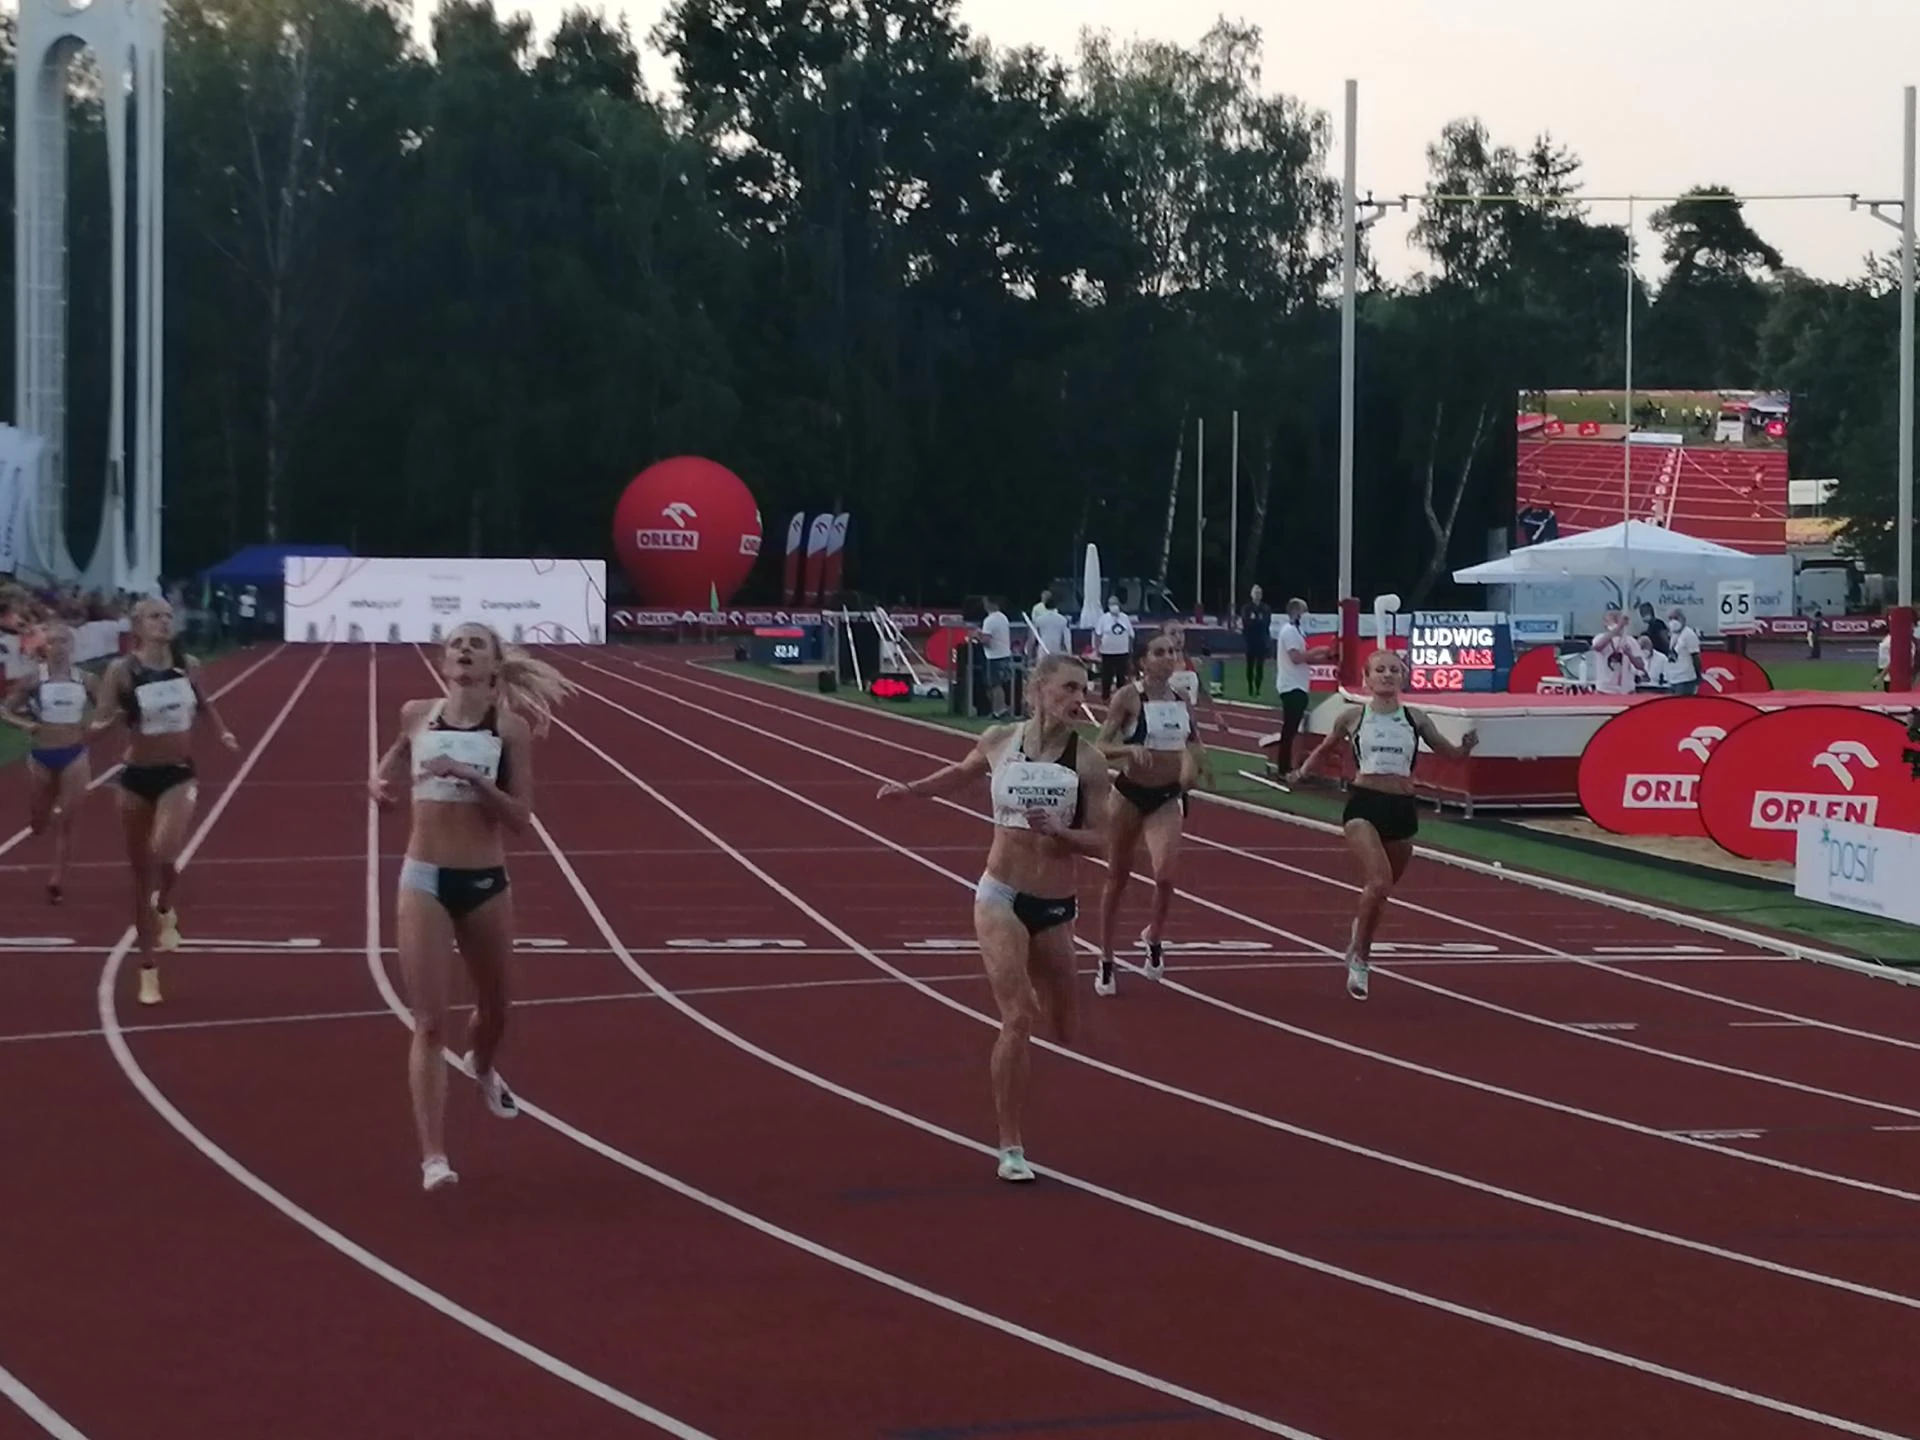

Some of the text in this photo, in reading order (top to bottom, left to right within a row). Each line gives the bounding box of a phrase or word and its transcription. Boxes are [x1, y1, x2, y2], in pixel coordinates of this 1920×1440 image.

[639, 533, 695, 547] ORLEN
[1721, 594, 1750, 615] 65
[1421, 613, 1471, 624] TYCZKA
[1412, 627, 1495, 647] LUDWIG
[1412, 649, 1453, 665] USA
[1411, 669, 1464, 689] 5.62
[1759, 798, 1869, 824] ORLEN
